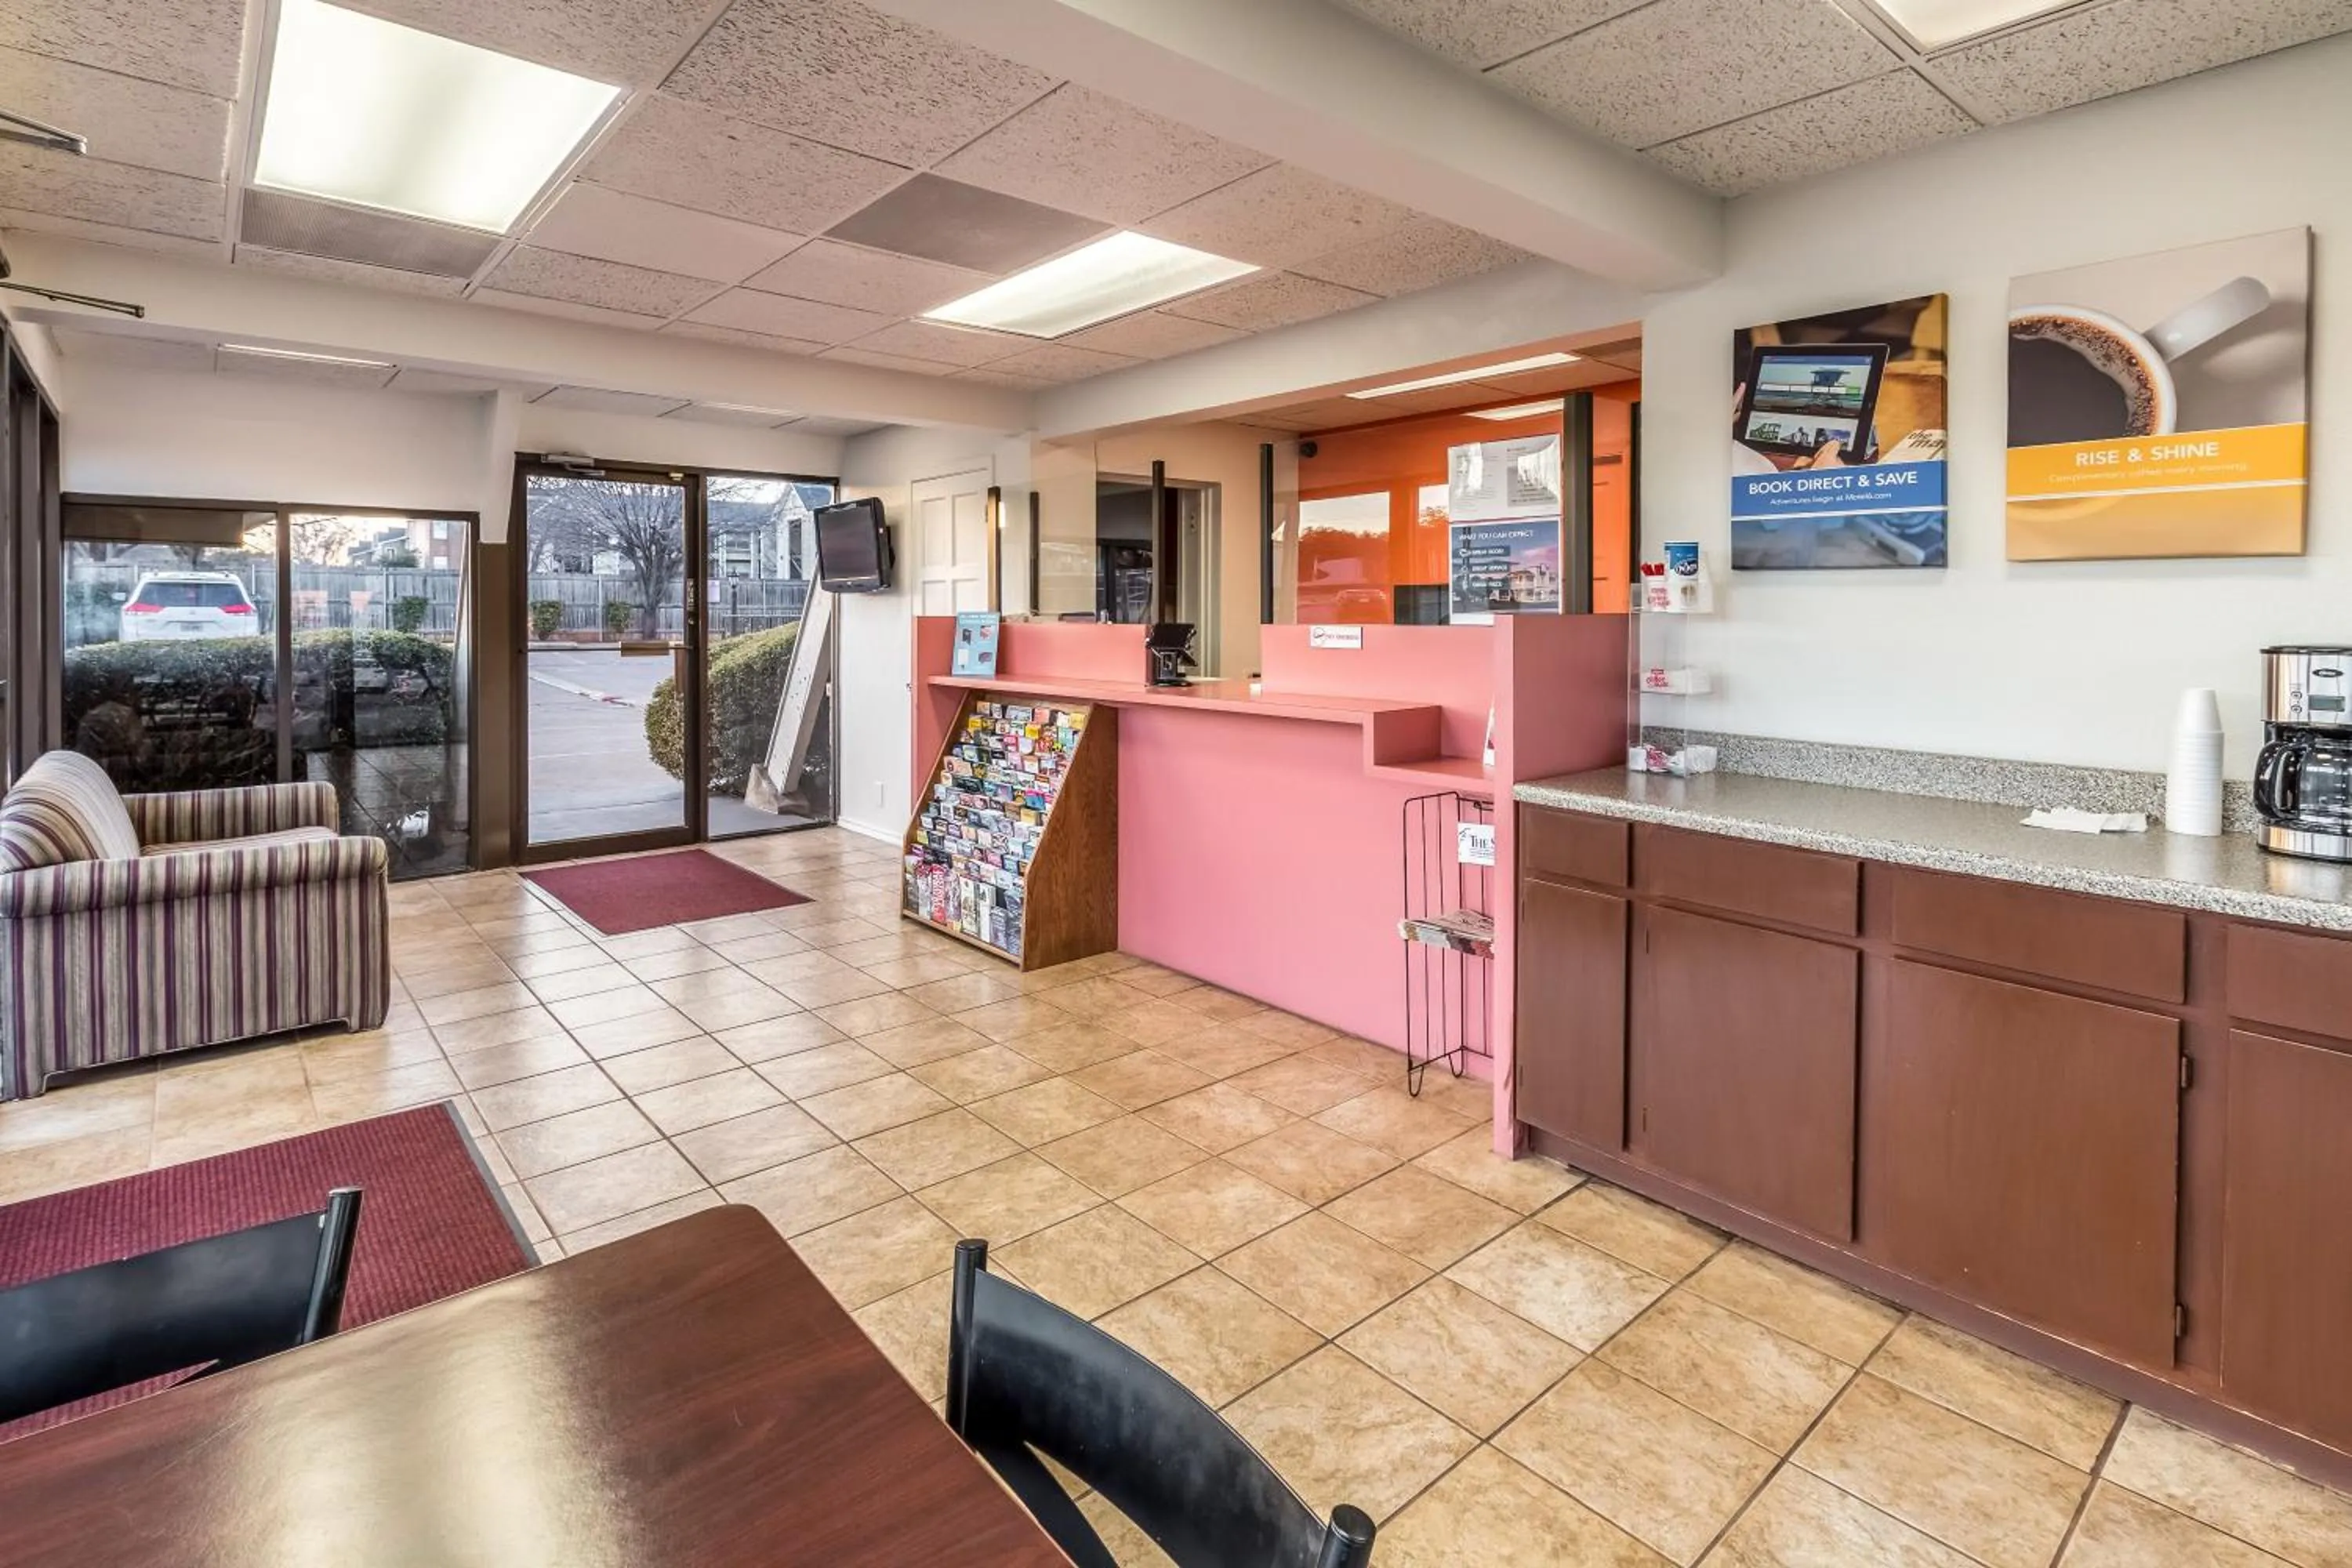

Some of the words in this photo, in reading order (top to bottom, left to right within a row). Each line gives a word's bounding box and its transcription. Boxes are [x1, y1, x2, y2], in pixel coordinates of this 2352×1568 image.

[2075, 450, 2120, 466] RISE
[2127, 448, 2143, 463] &
[2150, 441, 2220, 461] SHINE
[1748, 480, 1793, 495] BOOK
[1797, 477, 1854, 492] DIRECT
[1857, 475, 1870, 488] &
[1875, 470, 1918, 486] SAVE
[1812, 495, 1835, 504] begin
[1471, 835, 1489, 848] THE
